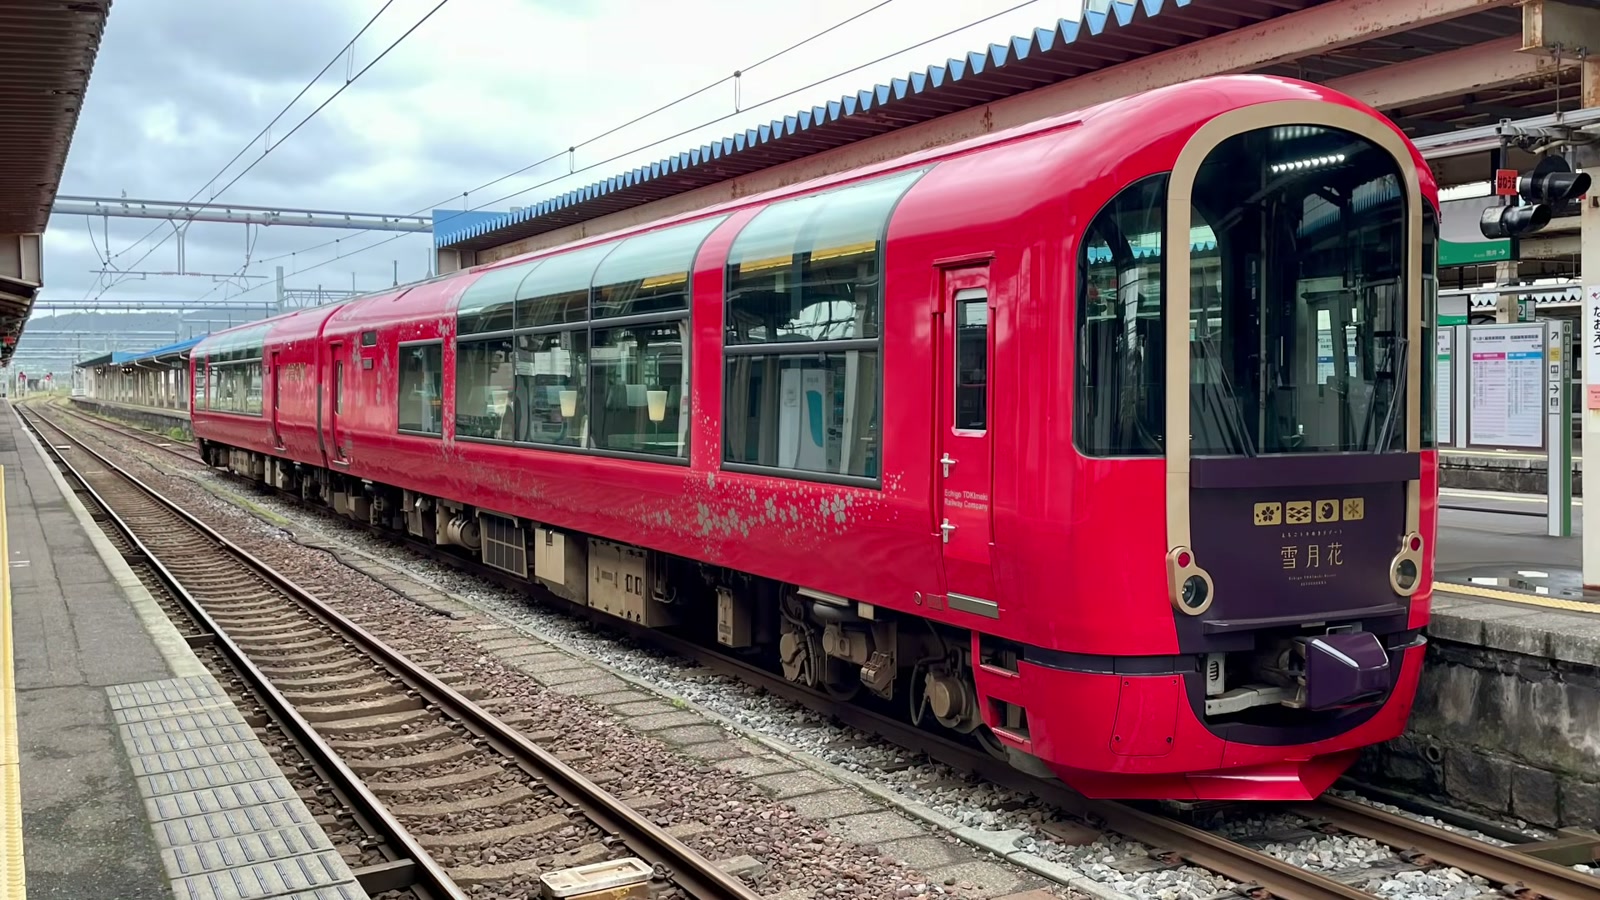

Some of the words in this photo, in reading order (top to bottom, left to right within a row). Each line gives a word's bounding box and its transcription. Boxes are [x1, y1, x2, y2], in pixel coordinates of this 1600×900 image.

[944, 489, 962, 500] Echigo
[944, 498, 963, 508] Railway
[963, 501, 988, 512] Company
[1280, 542, 1344, 569] 雪月花
